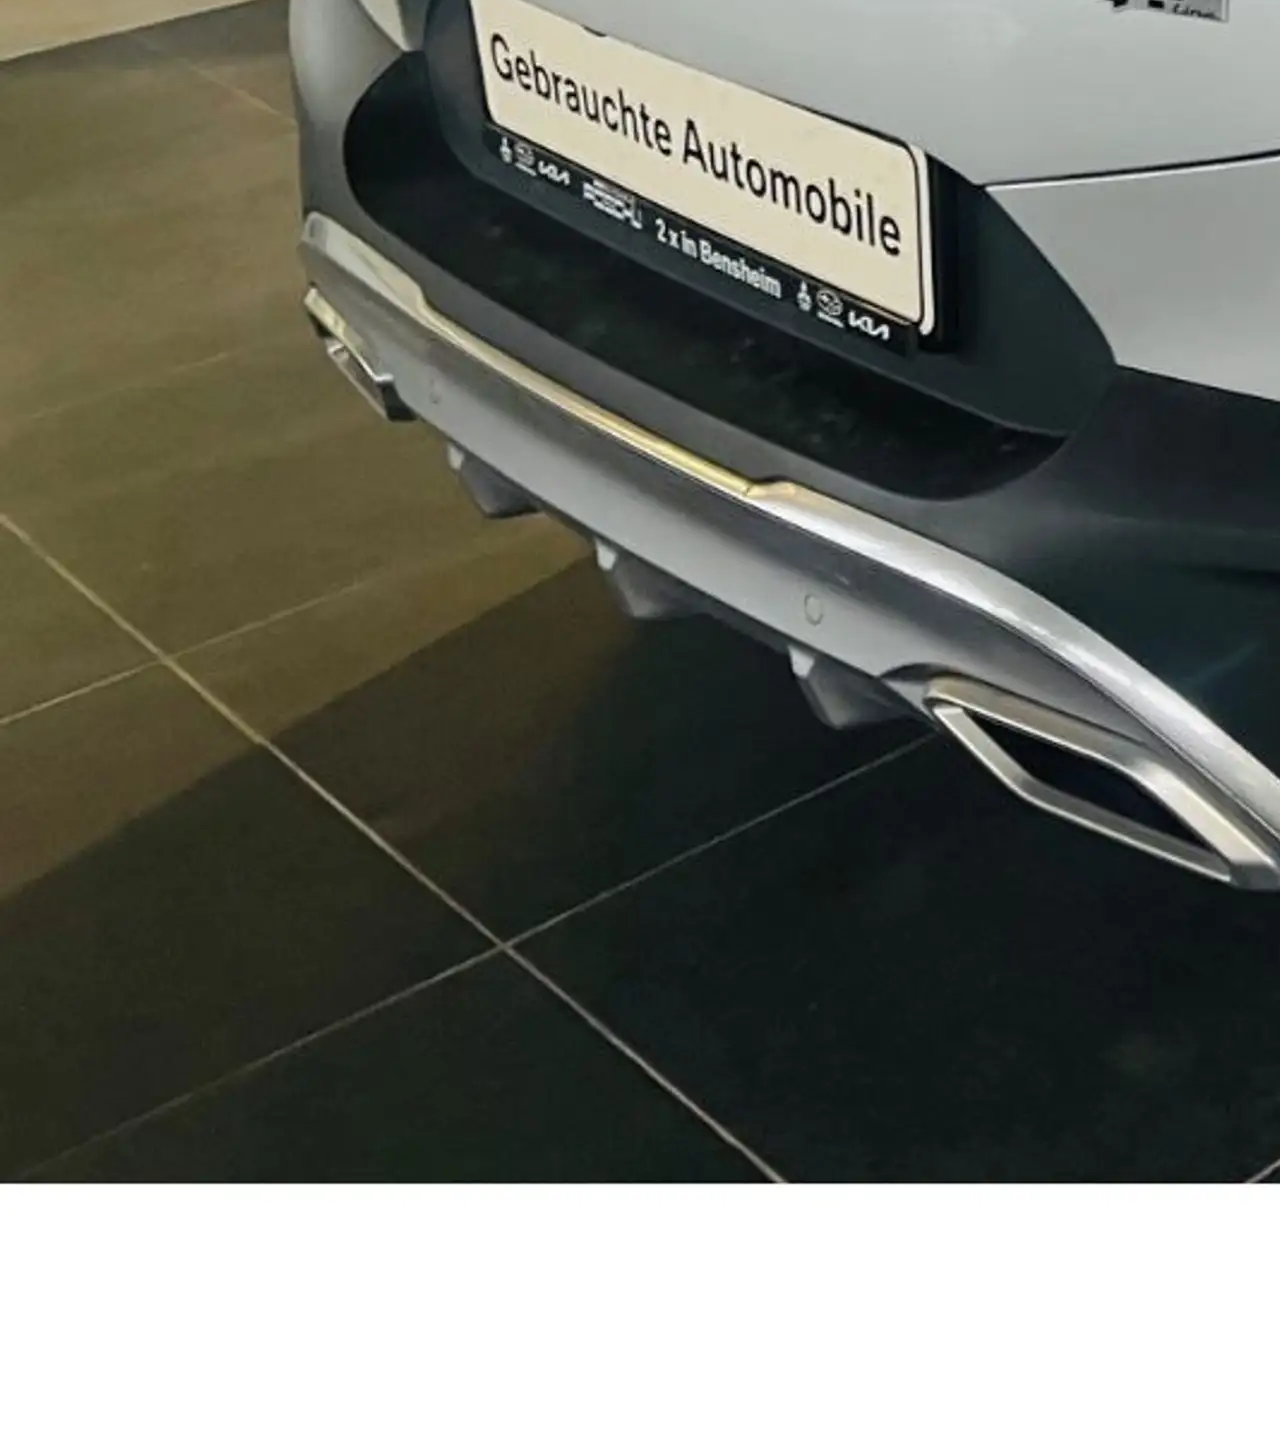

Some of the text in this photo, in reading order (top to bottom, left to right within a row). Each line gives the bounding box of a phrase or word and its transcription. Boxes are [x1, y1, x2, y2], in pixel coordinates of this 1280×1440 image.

[491, 33, 900, 255] Gebrauchte Automobile
[655, 218, 782, 299] 2 x in Bensheim
